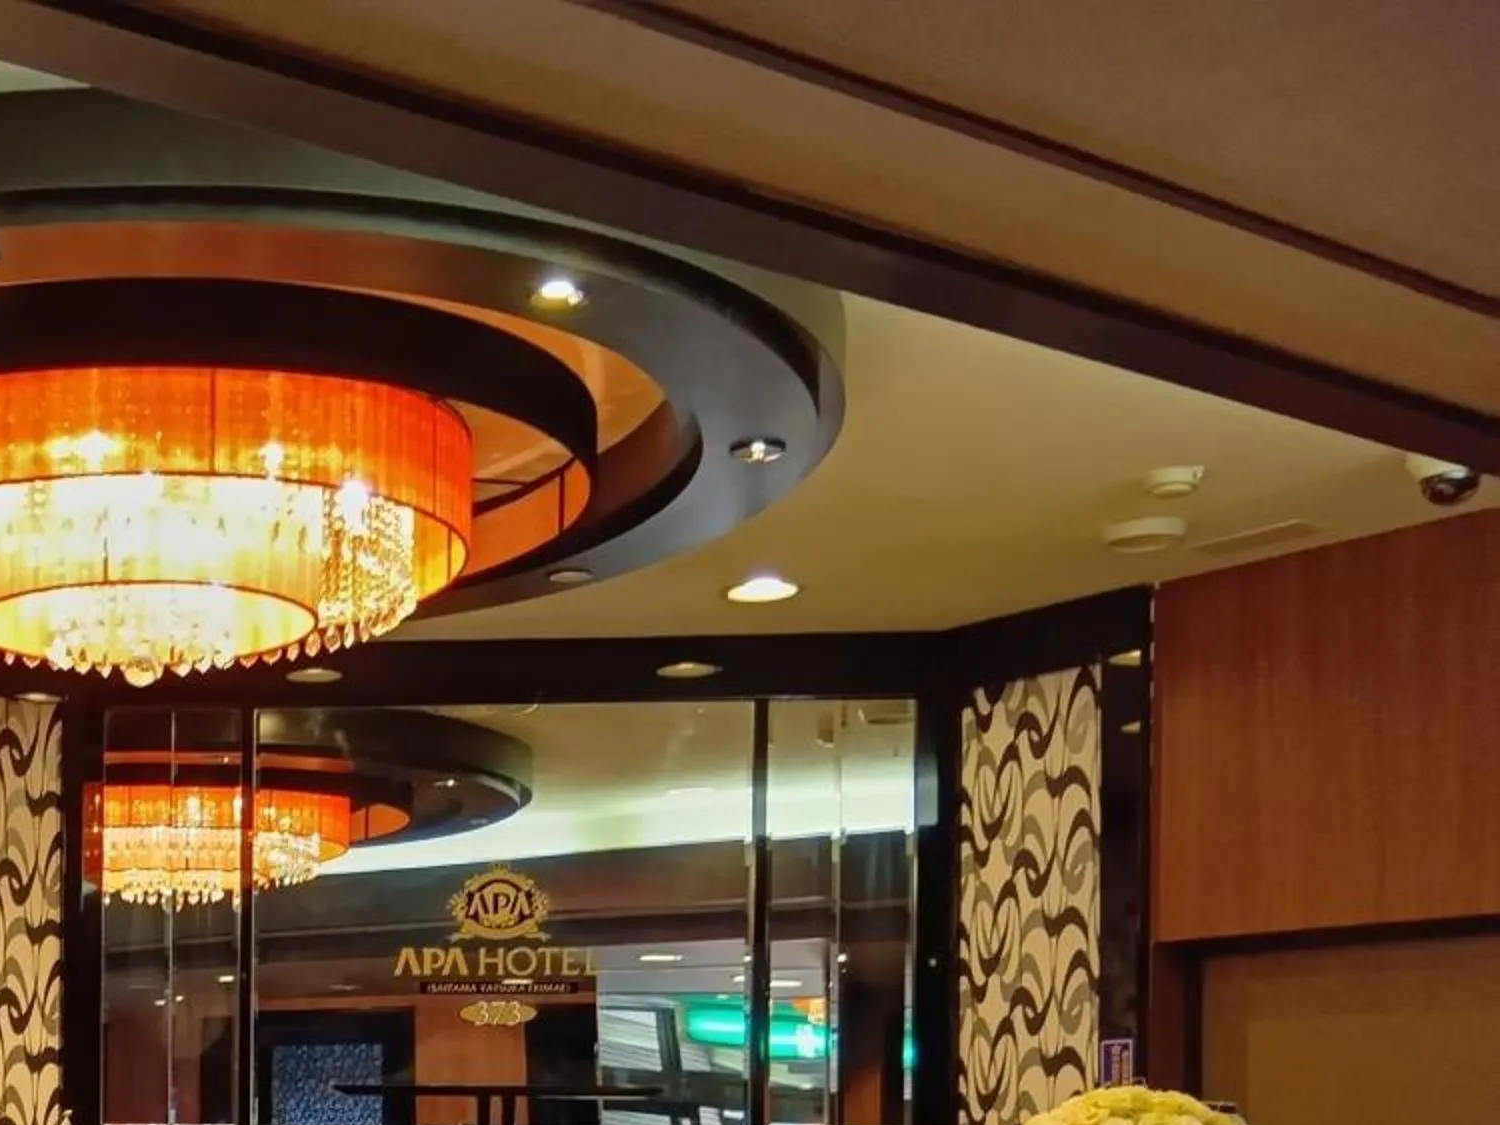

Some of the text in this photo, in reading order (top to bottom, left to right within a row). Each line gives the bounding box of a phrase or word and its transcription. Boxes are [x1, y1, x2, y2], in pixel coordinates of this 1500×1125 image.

[469, 892, 531, 916] APA
[394, 947, 597, 976] APA HOTEL
[474, 1001, 520, 1026] 373
